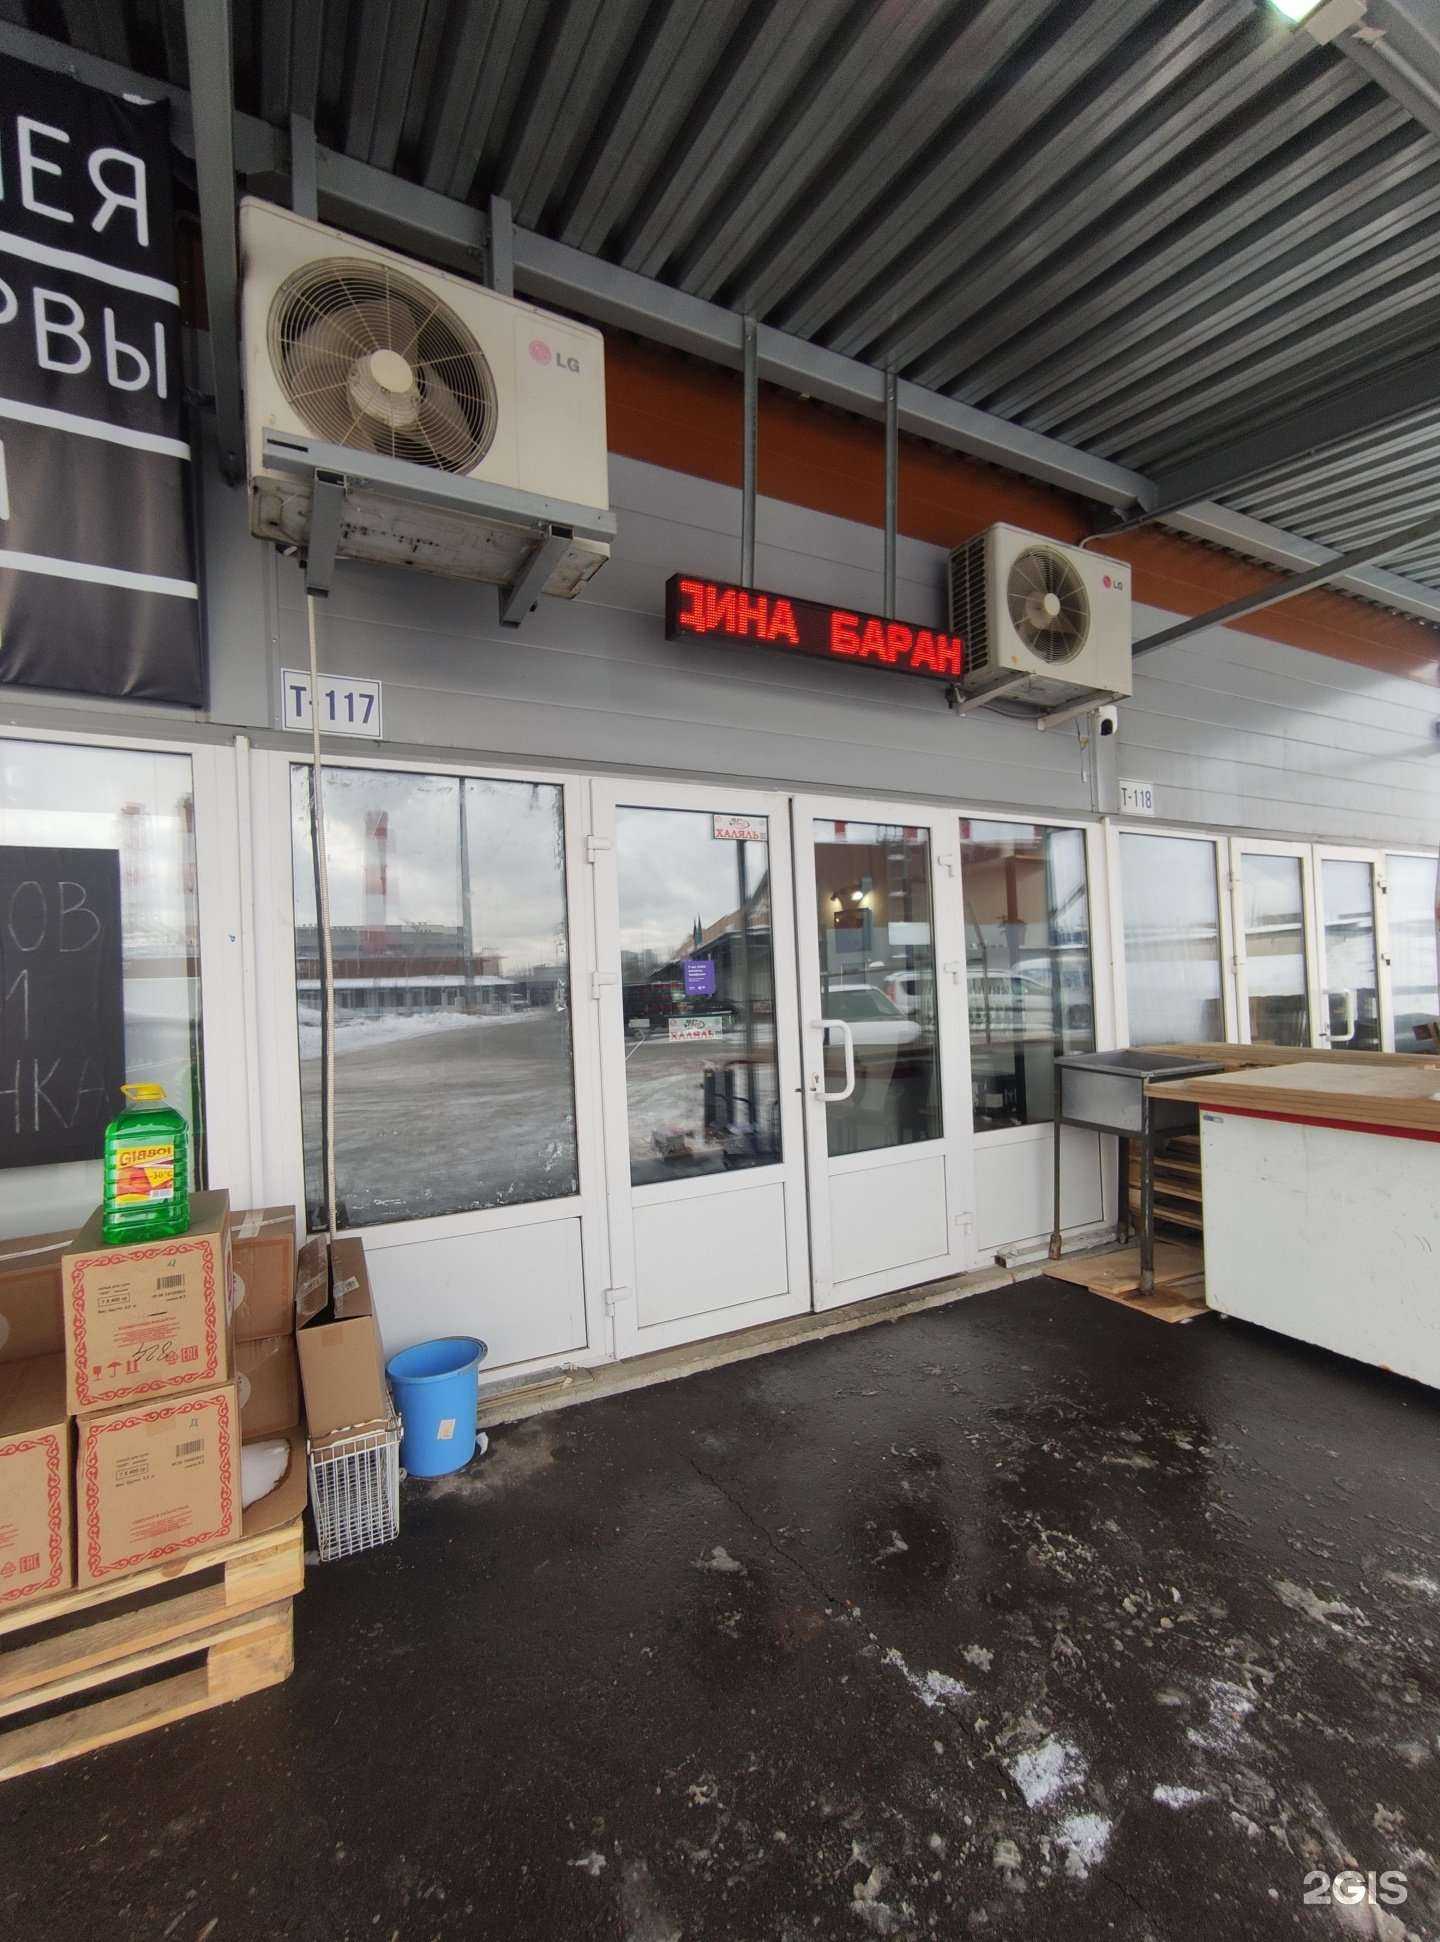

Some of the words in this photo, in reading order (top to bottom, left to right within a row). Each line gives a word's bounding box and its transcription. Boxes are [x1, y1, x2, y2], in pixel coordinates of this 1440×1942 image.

[0, 115, 148, 246] ЕЯ
[556, 352, 580, 373] LG
[830, 610, 962, 676] БАРАН
